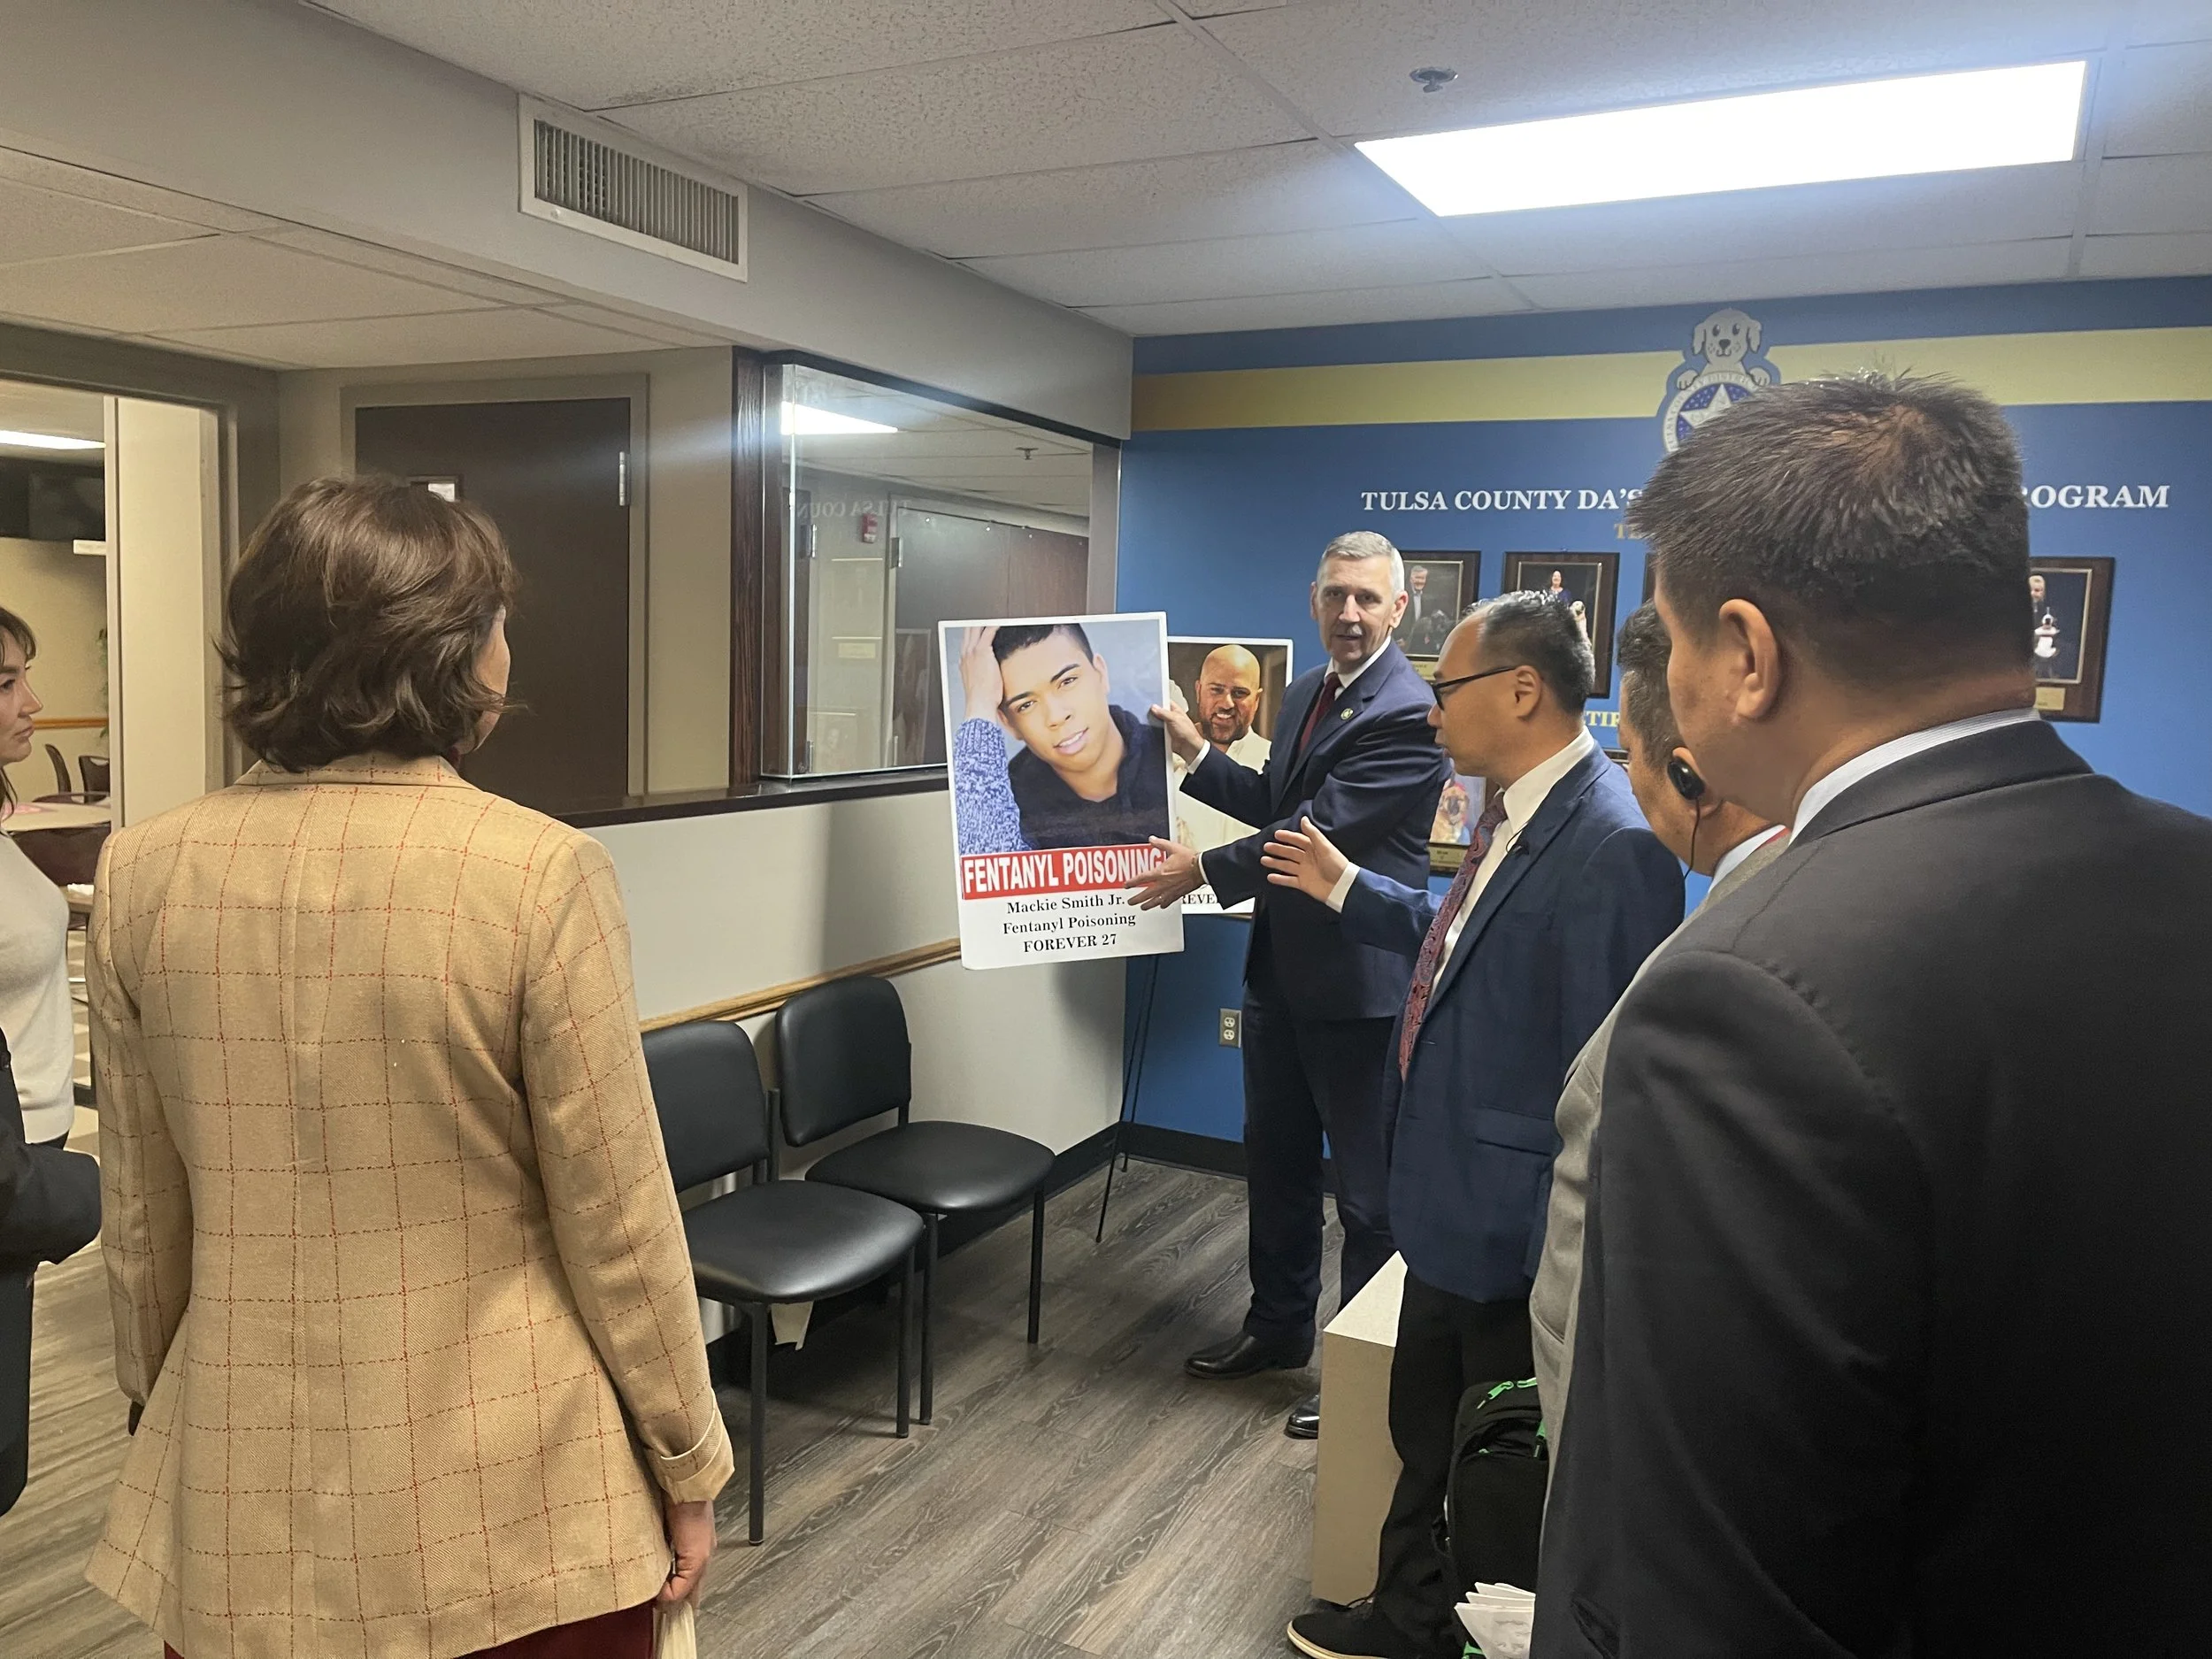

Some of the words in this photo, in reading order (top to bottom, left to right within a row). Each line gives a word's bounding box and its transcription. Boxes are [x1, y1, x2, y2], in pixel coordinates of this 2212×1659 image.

[1361, 491, 1448, 511] TULSA
[1455, 489, 1571, 511] COUNTY
[964, 853, 1059, 893] FENTANYL
[1007, 898, 1057, 914] Mackie
[1062, 894, 1104, 910] Smith
[1108, 893, 1125, 908] Jr.
[1003, 918, 1064, 936] Fentanyl
[1068, 913, 1136, 929] Poisoning
[1024, 936, 1097, 953] FOREVER
[1102, 933, 1118, 946] 27
